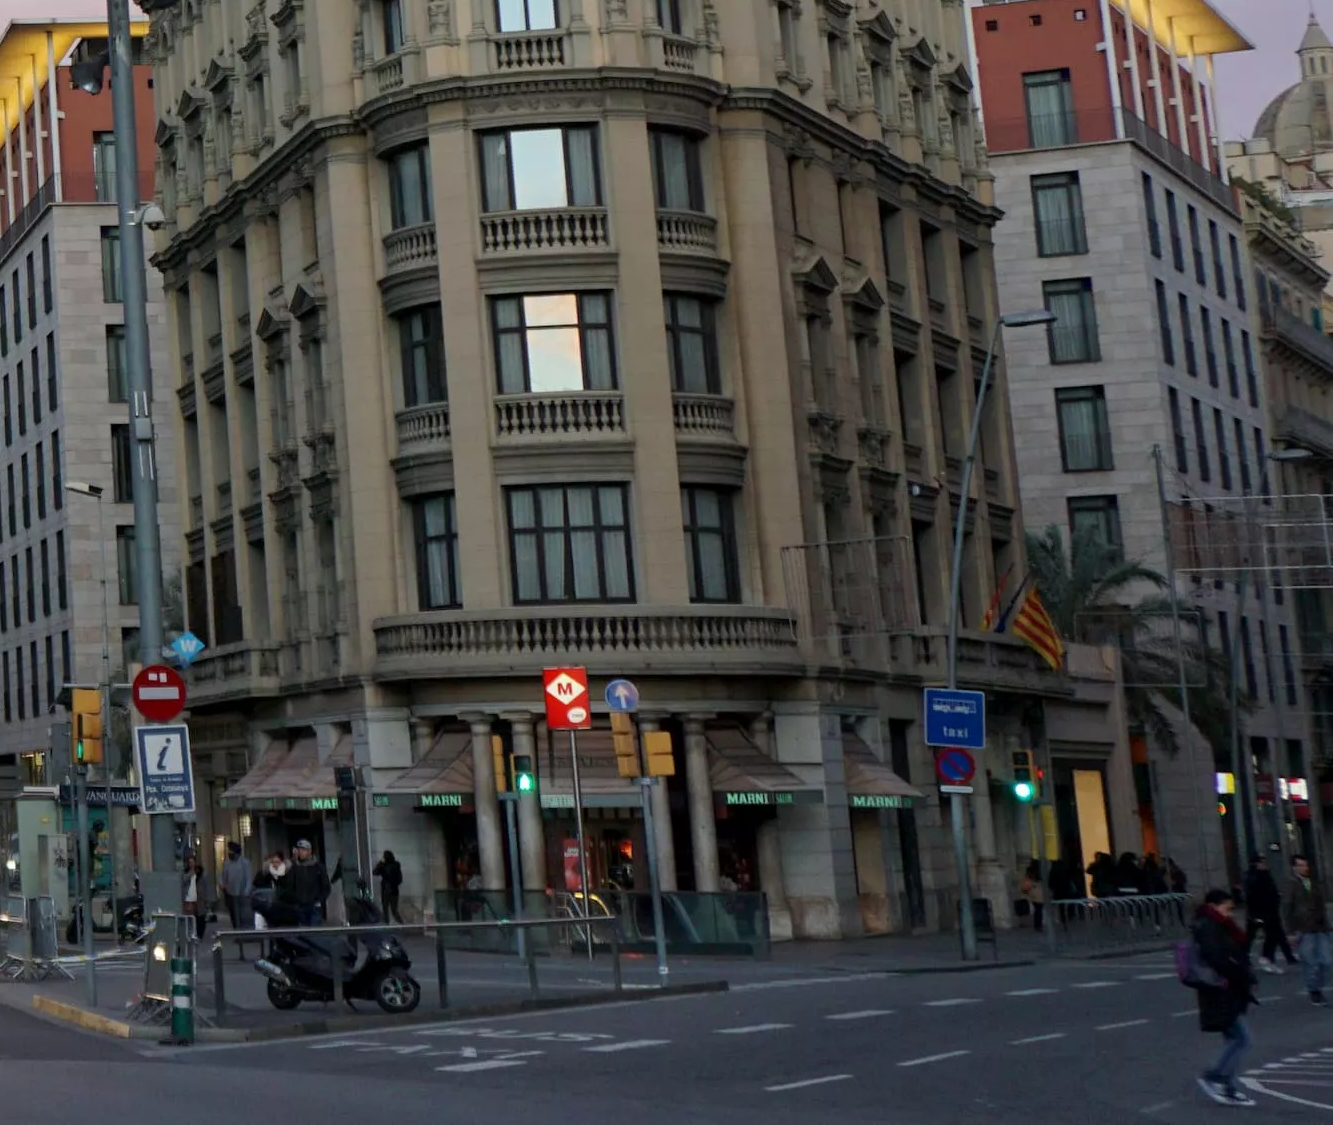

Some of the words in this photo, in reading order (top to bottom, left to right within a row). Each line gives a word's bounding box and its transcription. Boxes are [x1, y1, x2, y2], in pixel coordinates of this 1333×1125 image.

[180, 640, 197, 653] W
[557, 682, 573, 696] M
[943, 725, 969, 739] taxi
[421, 793, 463, 807] MARNI
[726, 792, 769, 805] MARNI
